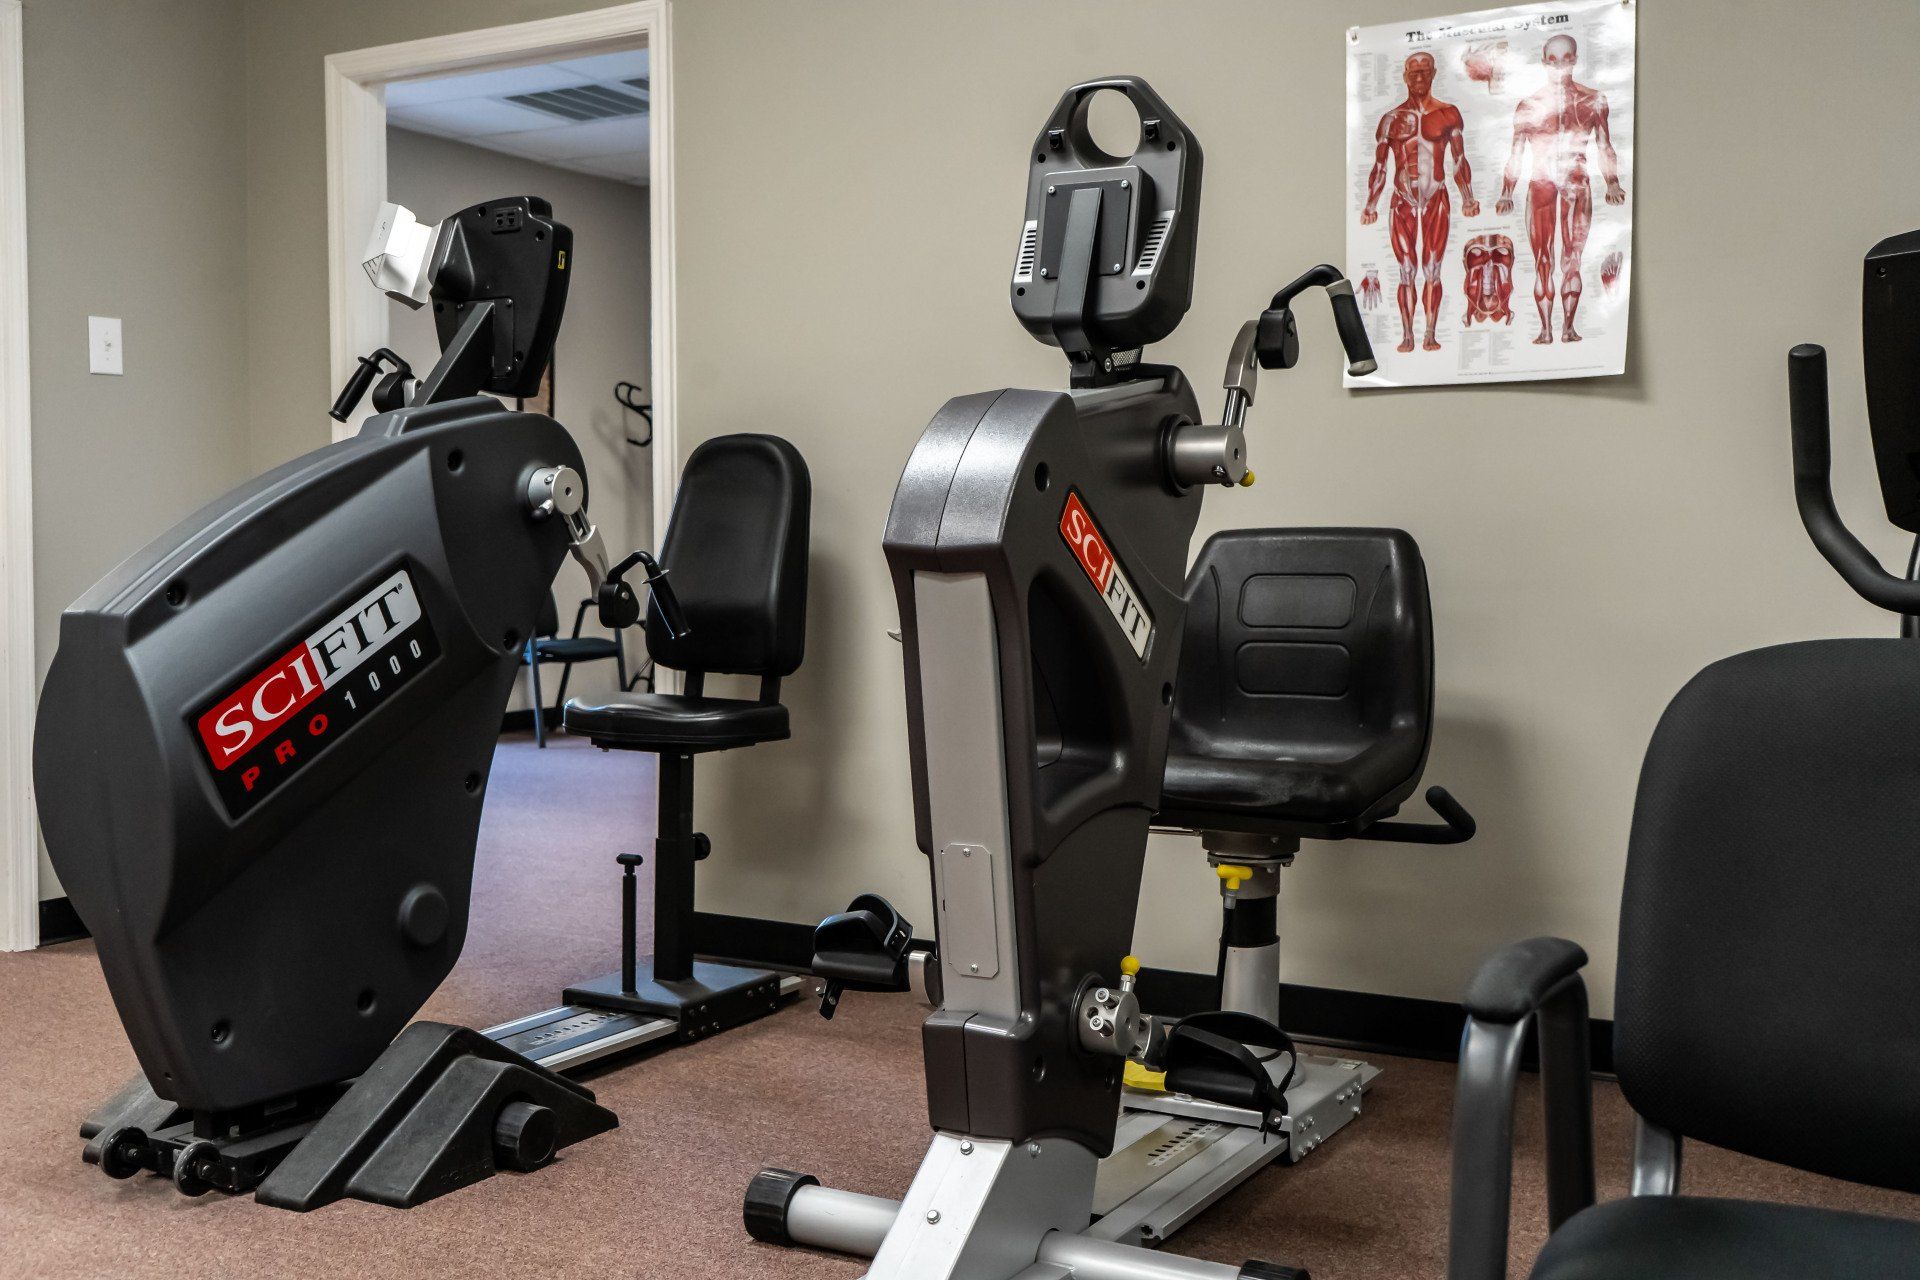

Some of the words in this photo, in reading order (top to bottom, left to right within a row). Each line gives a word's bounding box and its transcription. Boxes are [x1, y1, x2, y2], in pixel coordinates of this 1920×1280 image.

[1514, 14, 1570, 31] ytem
[1067, 509, 1146, 641] SCIFIT
[215, 585, 400, 756] SCIFIT
[240, 713, 329, 792] PRO
[344, 638, 422, 710] 1000
